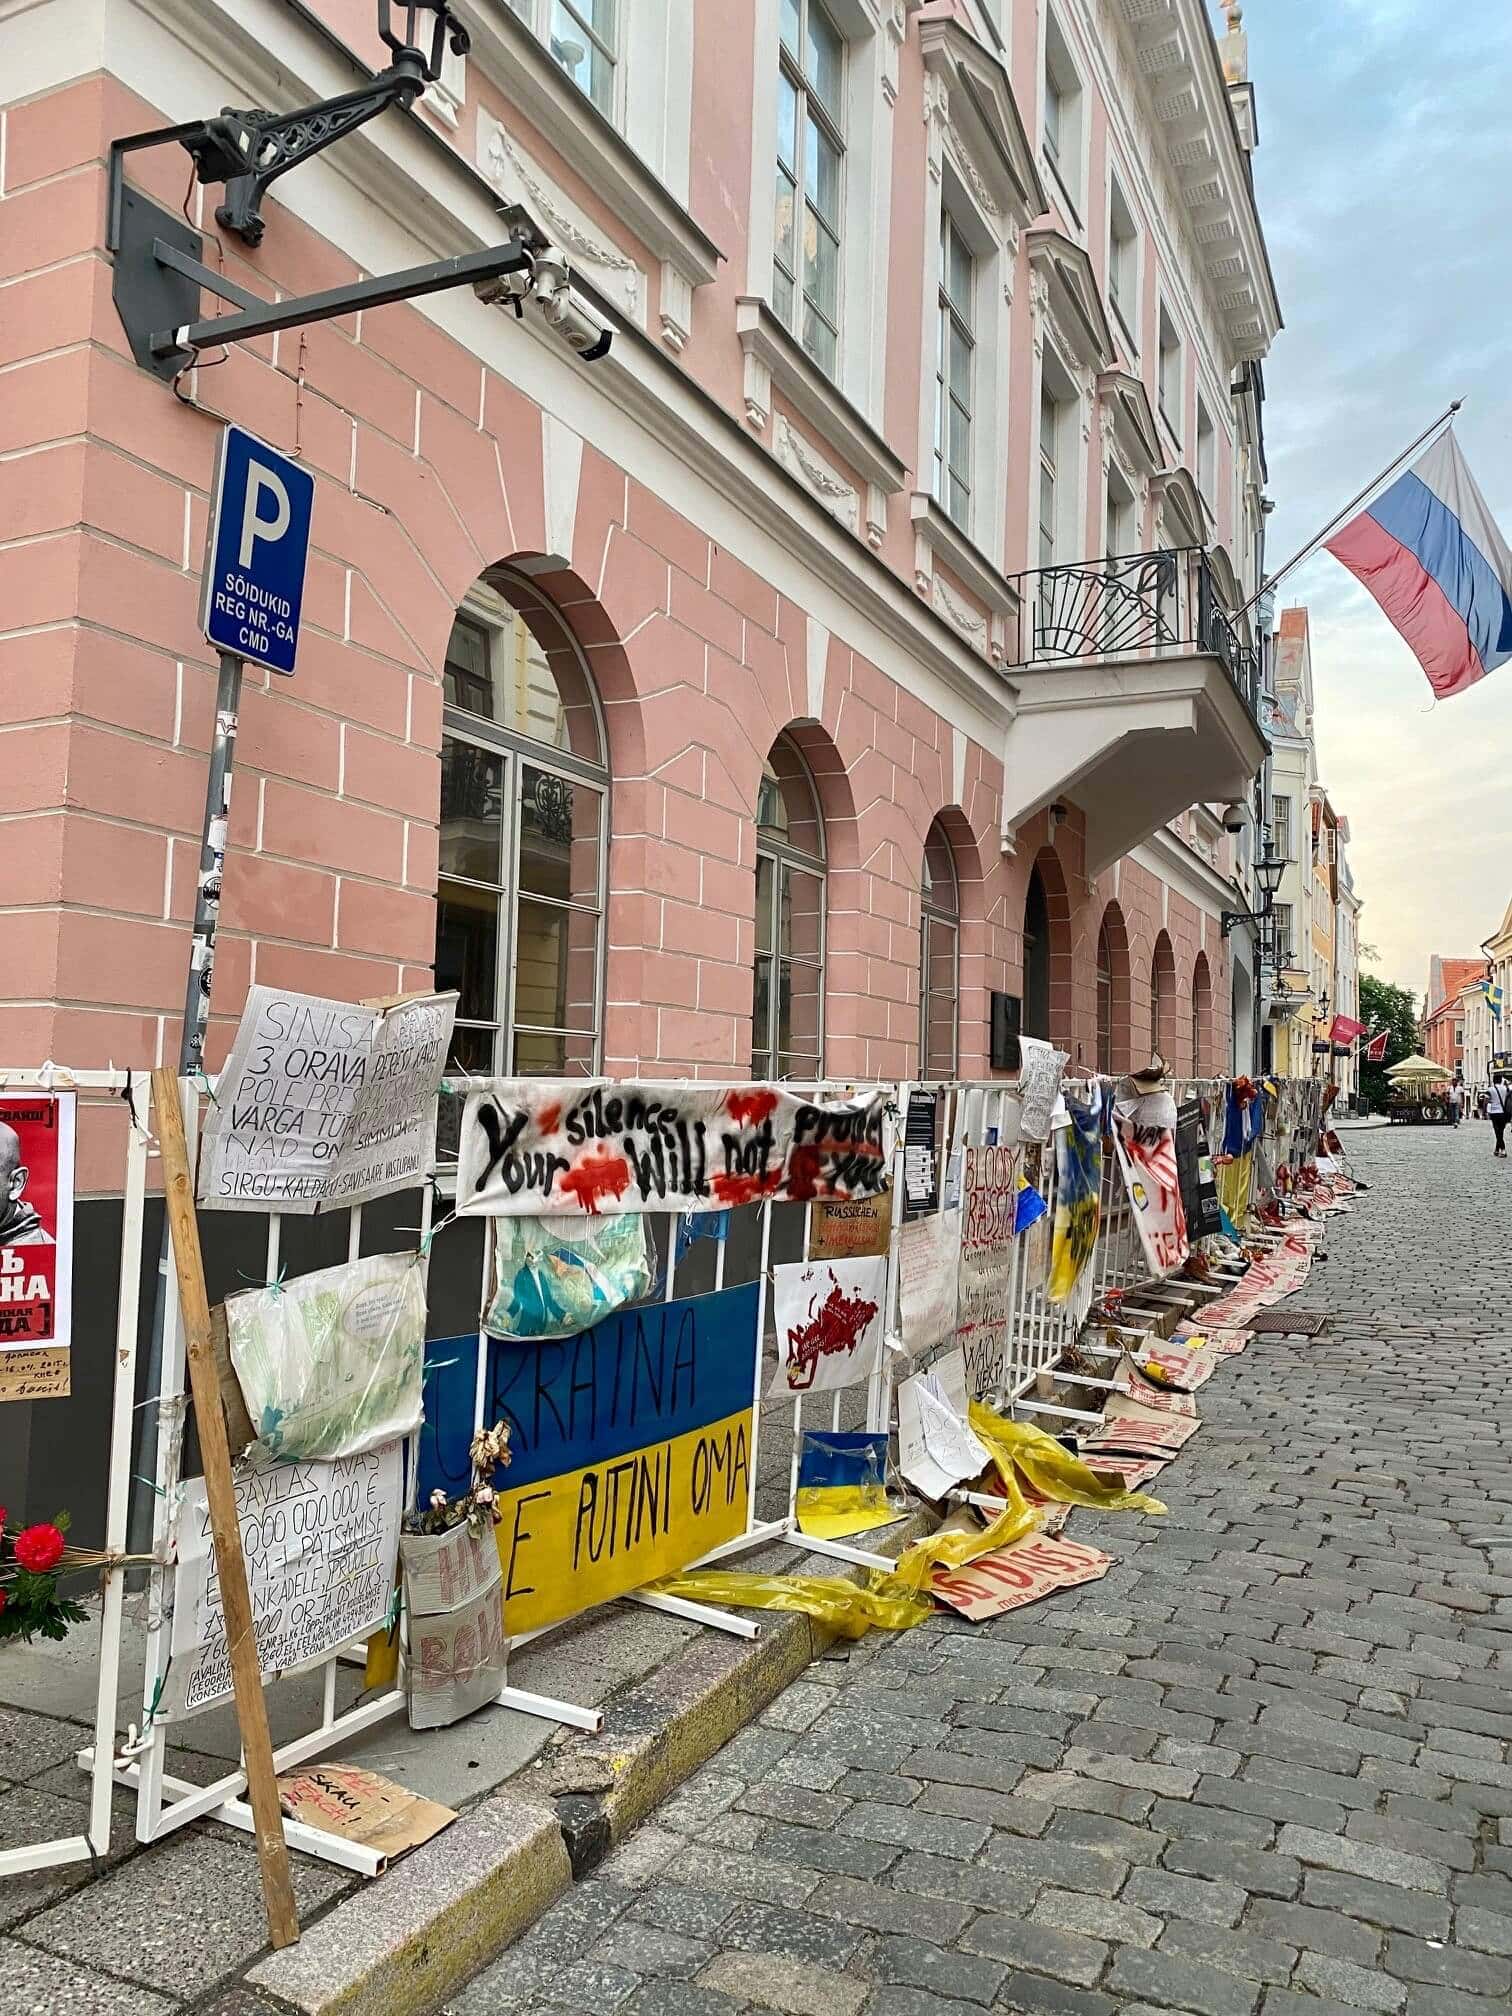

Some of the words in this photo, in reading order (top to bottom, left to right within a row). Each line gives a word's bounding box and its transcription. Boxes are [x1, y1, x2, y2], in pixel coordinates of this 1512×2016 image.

[239, 458, 291, 569] P
[216, 591, 246, 620] REG
[225, 573, 291, 618] SÕIDUKID
[239, 627, 269, 653] CMD
[247, 1045, 275, 1075] 3
[284, 1048, 368, 1086] ORAVA
[237, 1076, 305, 1107] POLE
[231, 1104, 305, 1135] VARGA
[566, 1085, 678, 1145] silence
[225, 1133, 299, 1158] NAD
[312, 1141, 345, 1159] ON
[824, 1206, 878, 1219] RUSSISCHEN
[574, 1444, 674, 1572] PUTINI
[692, 1423, 751, 1515] OMA
